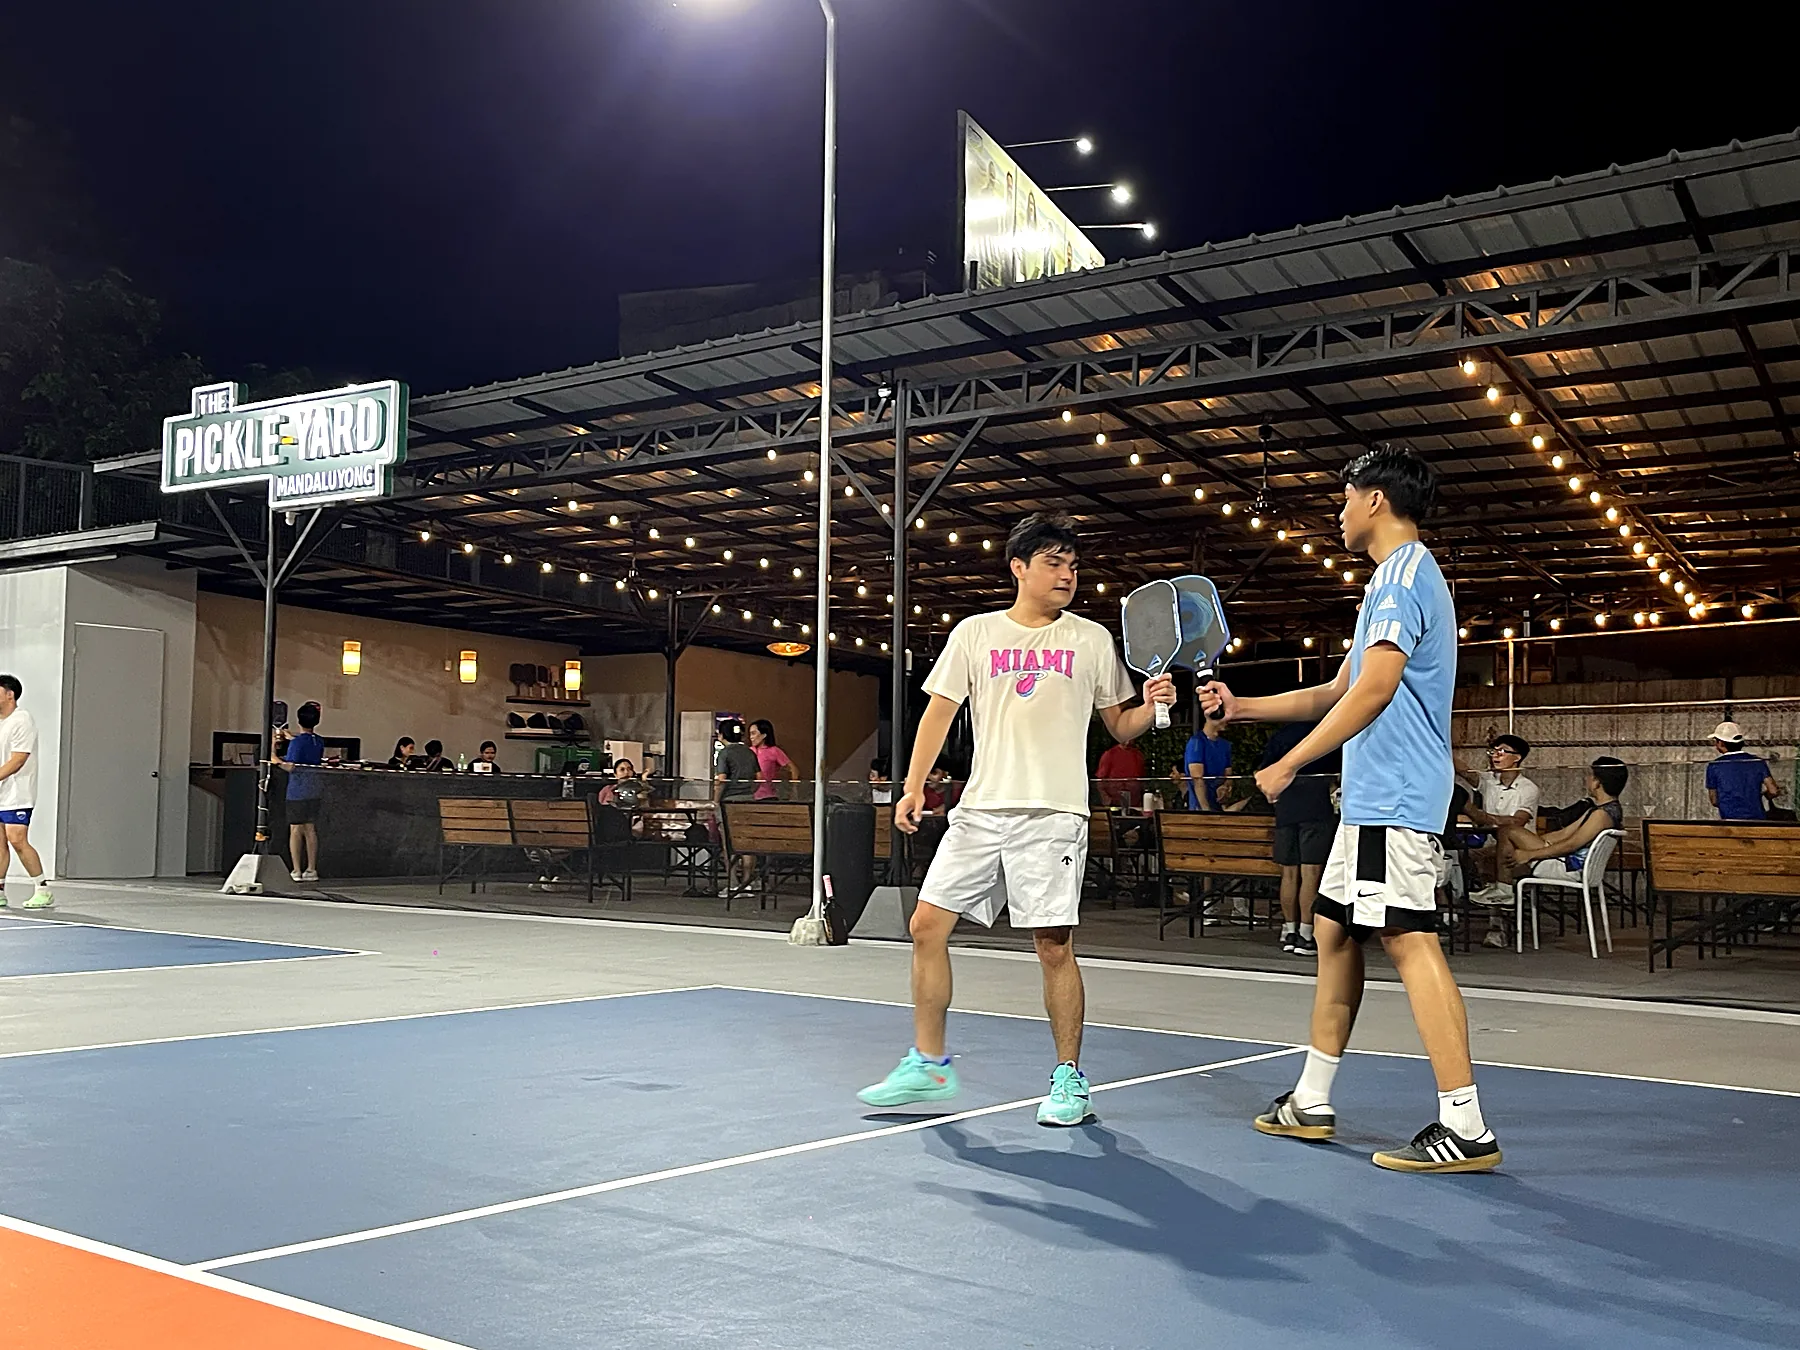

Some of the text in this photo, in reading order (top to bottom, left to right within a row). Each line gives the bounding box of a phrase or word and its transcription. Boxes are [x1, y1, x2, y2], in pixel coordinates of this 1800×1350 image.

[199, 393, 226, 415] THE
[276, 464, 373, 497] MANDALUYONG
[990, 649, 1075, 678] MIAMI
